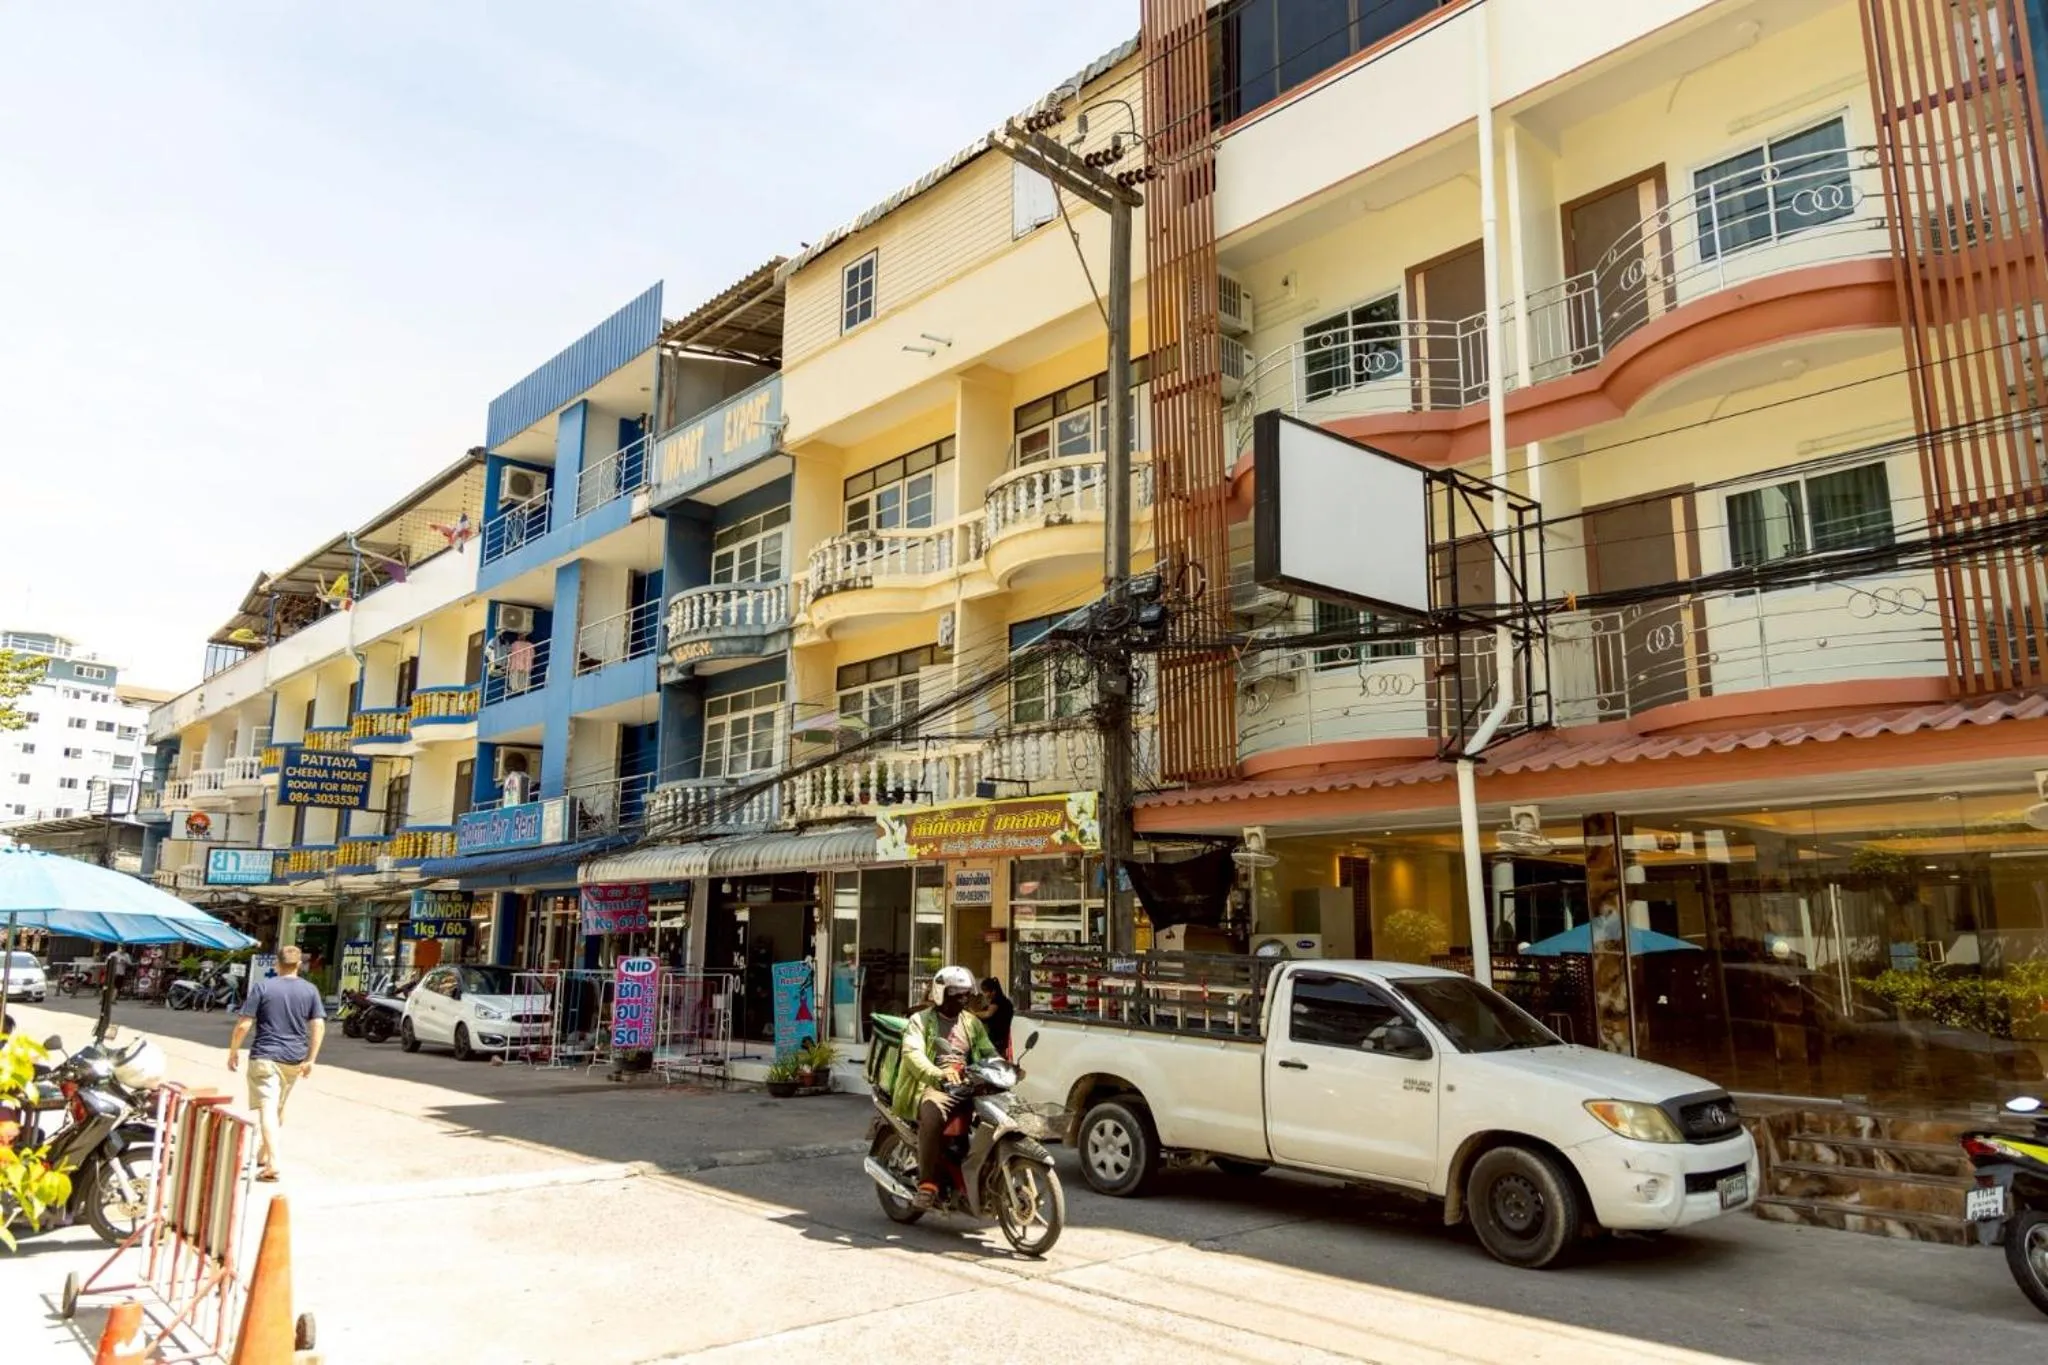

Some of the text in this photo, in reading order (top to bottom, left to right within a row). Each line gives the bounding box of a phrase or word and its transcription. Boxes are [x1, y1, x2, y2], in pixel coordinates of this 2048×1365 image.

[300, 754, 357, 769] PATTAYA
[286, 766, 369, 782] CHEENA HOUSE
[287, 780, 363, 793] ROOM FOR RENT
[414, 902, 470, 919] LAUNDRY
[624, 960, 653, 973] NID
[618, 977, 642, 998] ซัก
